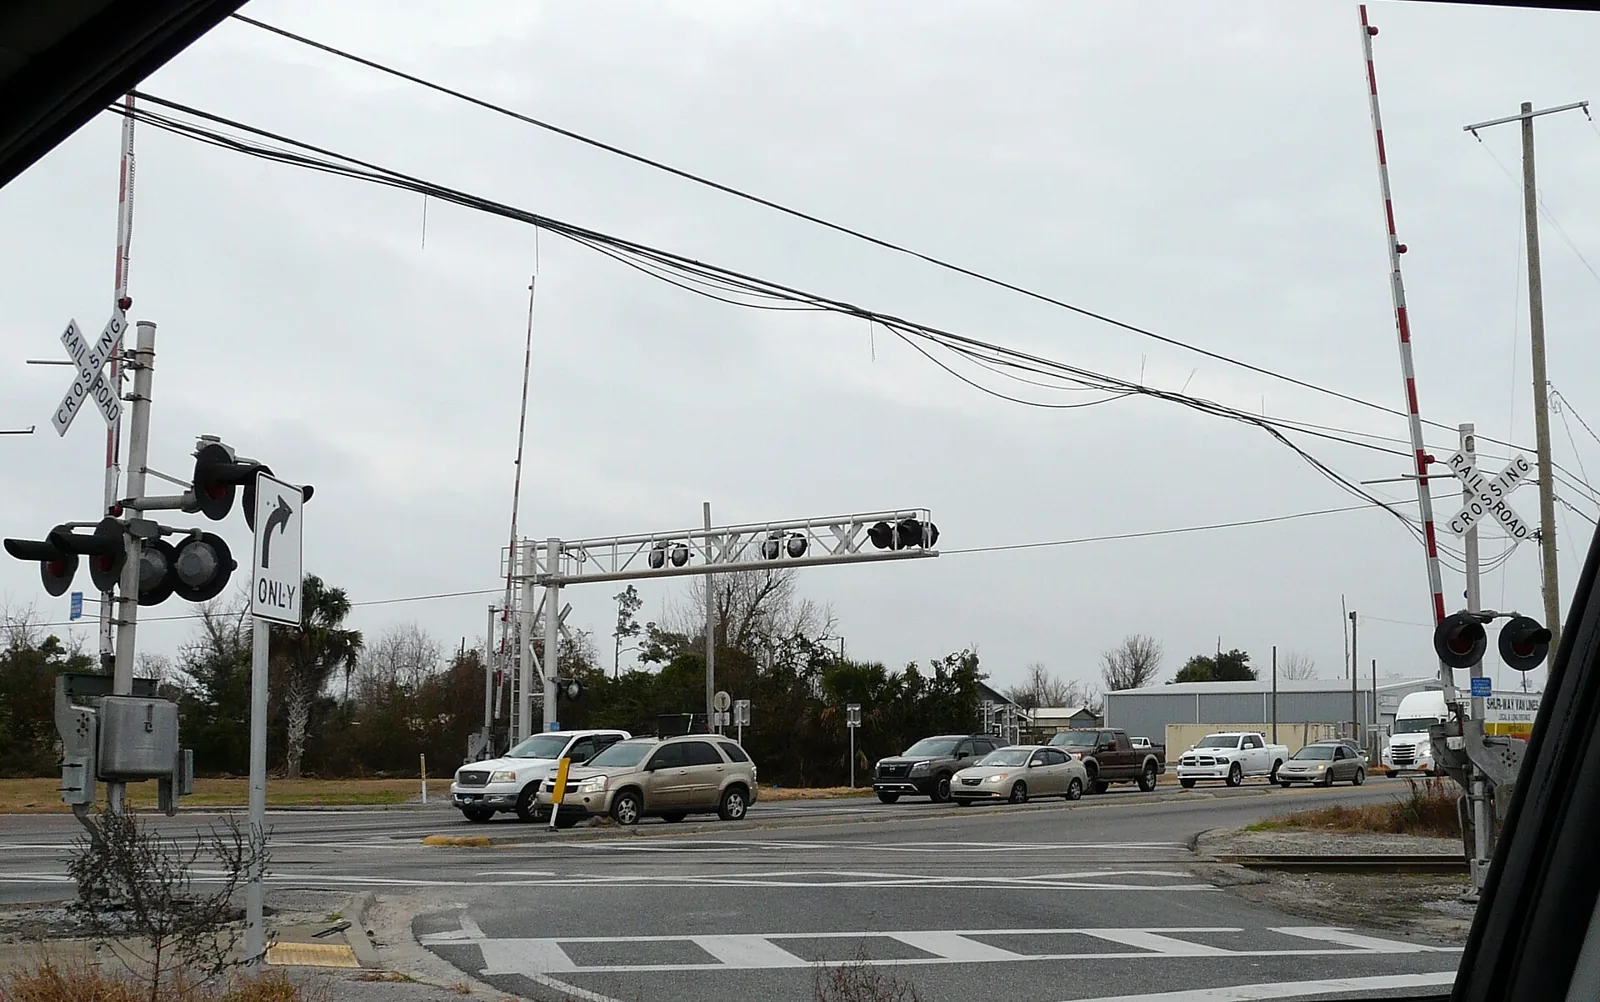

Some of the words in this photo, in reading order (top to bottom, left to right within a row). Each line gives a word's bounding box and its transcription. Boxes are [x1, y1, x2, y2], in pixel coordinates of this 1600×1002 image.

[57, 318, 120, 424] CROSSING
[63, 324, 86, 367] RAIL
[92, 377, 119, 421] ROAD
[1450, 453, 1483, 493] RAIL
[1491, 500, 1527, 538] ROAD
[1451, 459, 1529, 534] CROSSING
[258, 577, 296, 610] ONLY
